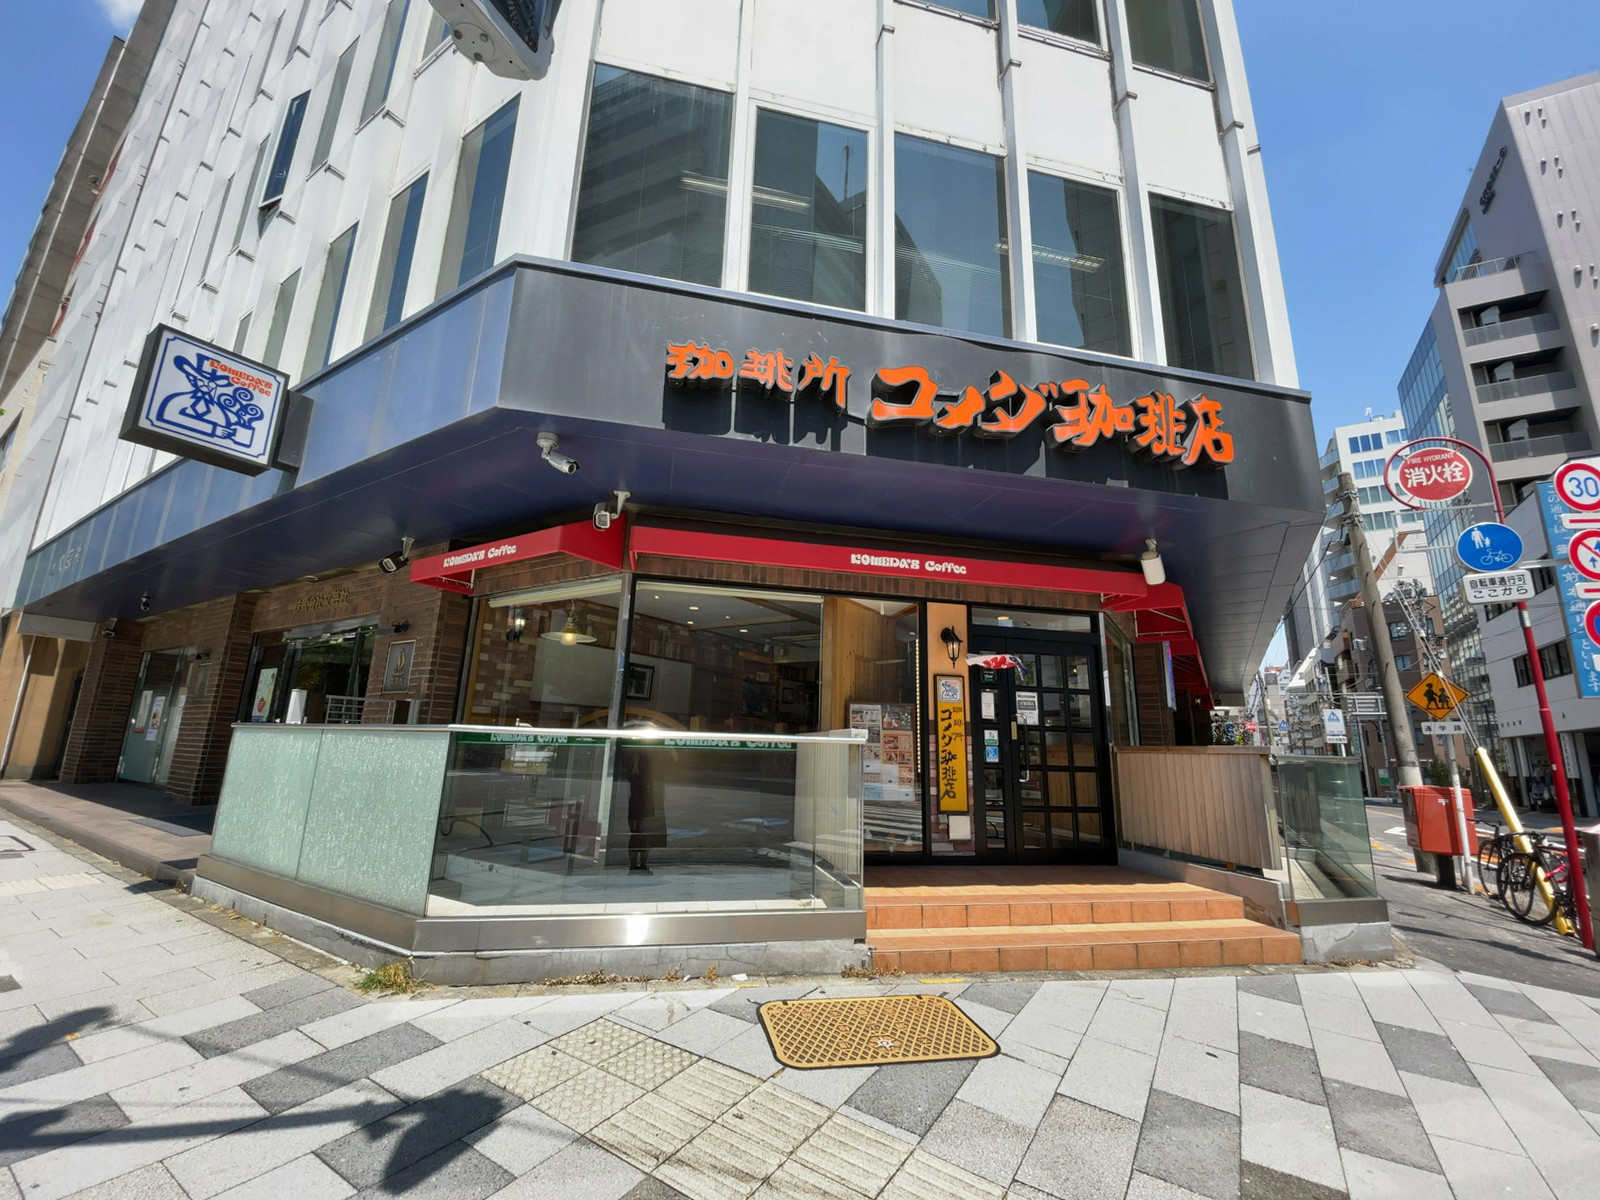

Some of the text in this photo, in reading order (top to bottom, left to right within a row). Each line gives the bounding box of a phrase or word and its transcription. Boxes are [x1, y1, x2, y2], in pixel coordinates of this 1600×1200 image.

[209, 360, 273, 389] KOMEDA'S
[230, 376, 271, 396] Coffee
[667, 341, 1235, 465] 珈琲所 コメダ珈琲店
[1424, 452, 1454, 462] HYDRANT
[1404, 461, 1466, 488] 消火栓
[1568, 476, 1599, 498] 30
[443, 545, 517, 568] KOMEDA'S Coffee
[850, 554, 967, 574] KOMEDA'S Coffee
[1469, 574, 1526, 588] 自転車通行可
[1473, 586, 1528, 599] ここから
